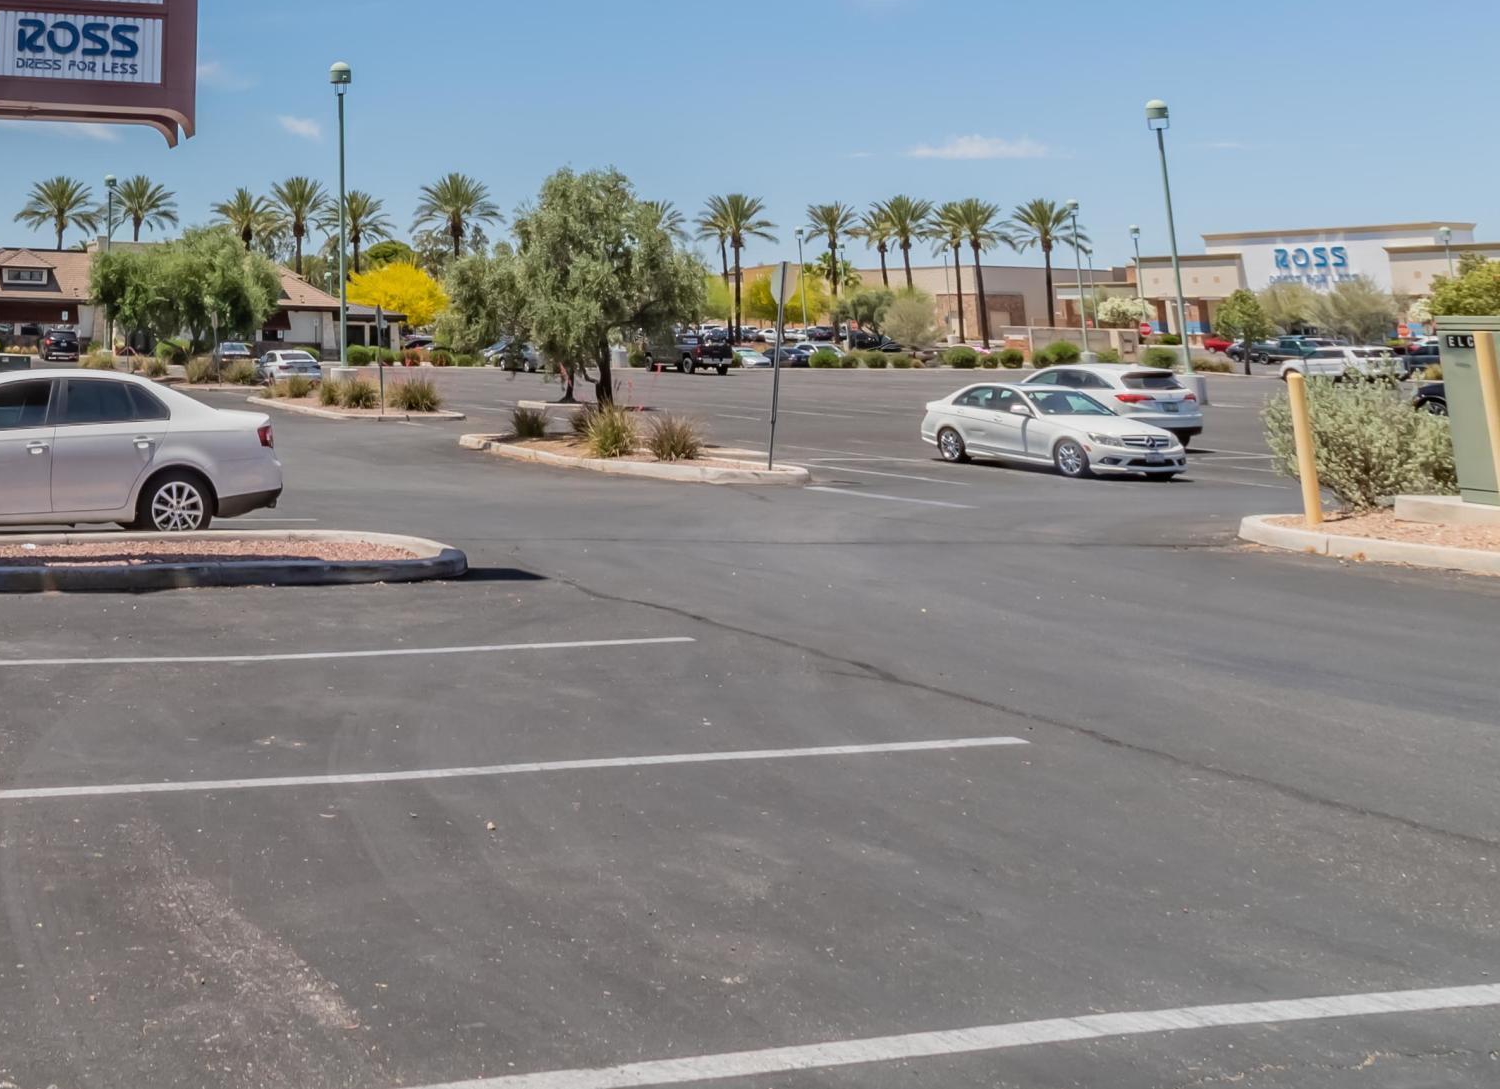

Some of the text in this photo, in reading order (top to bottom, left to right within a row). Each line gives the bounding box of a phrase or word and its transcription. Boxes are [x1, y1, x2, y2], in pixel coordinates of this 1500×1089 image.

[17, 18, 140, 58] ROSS
[16, 57, 139, 75] DRESS FOR LESS
[1274, 246, 1347, 269] ROSS
